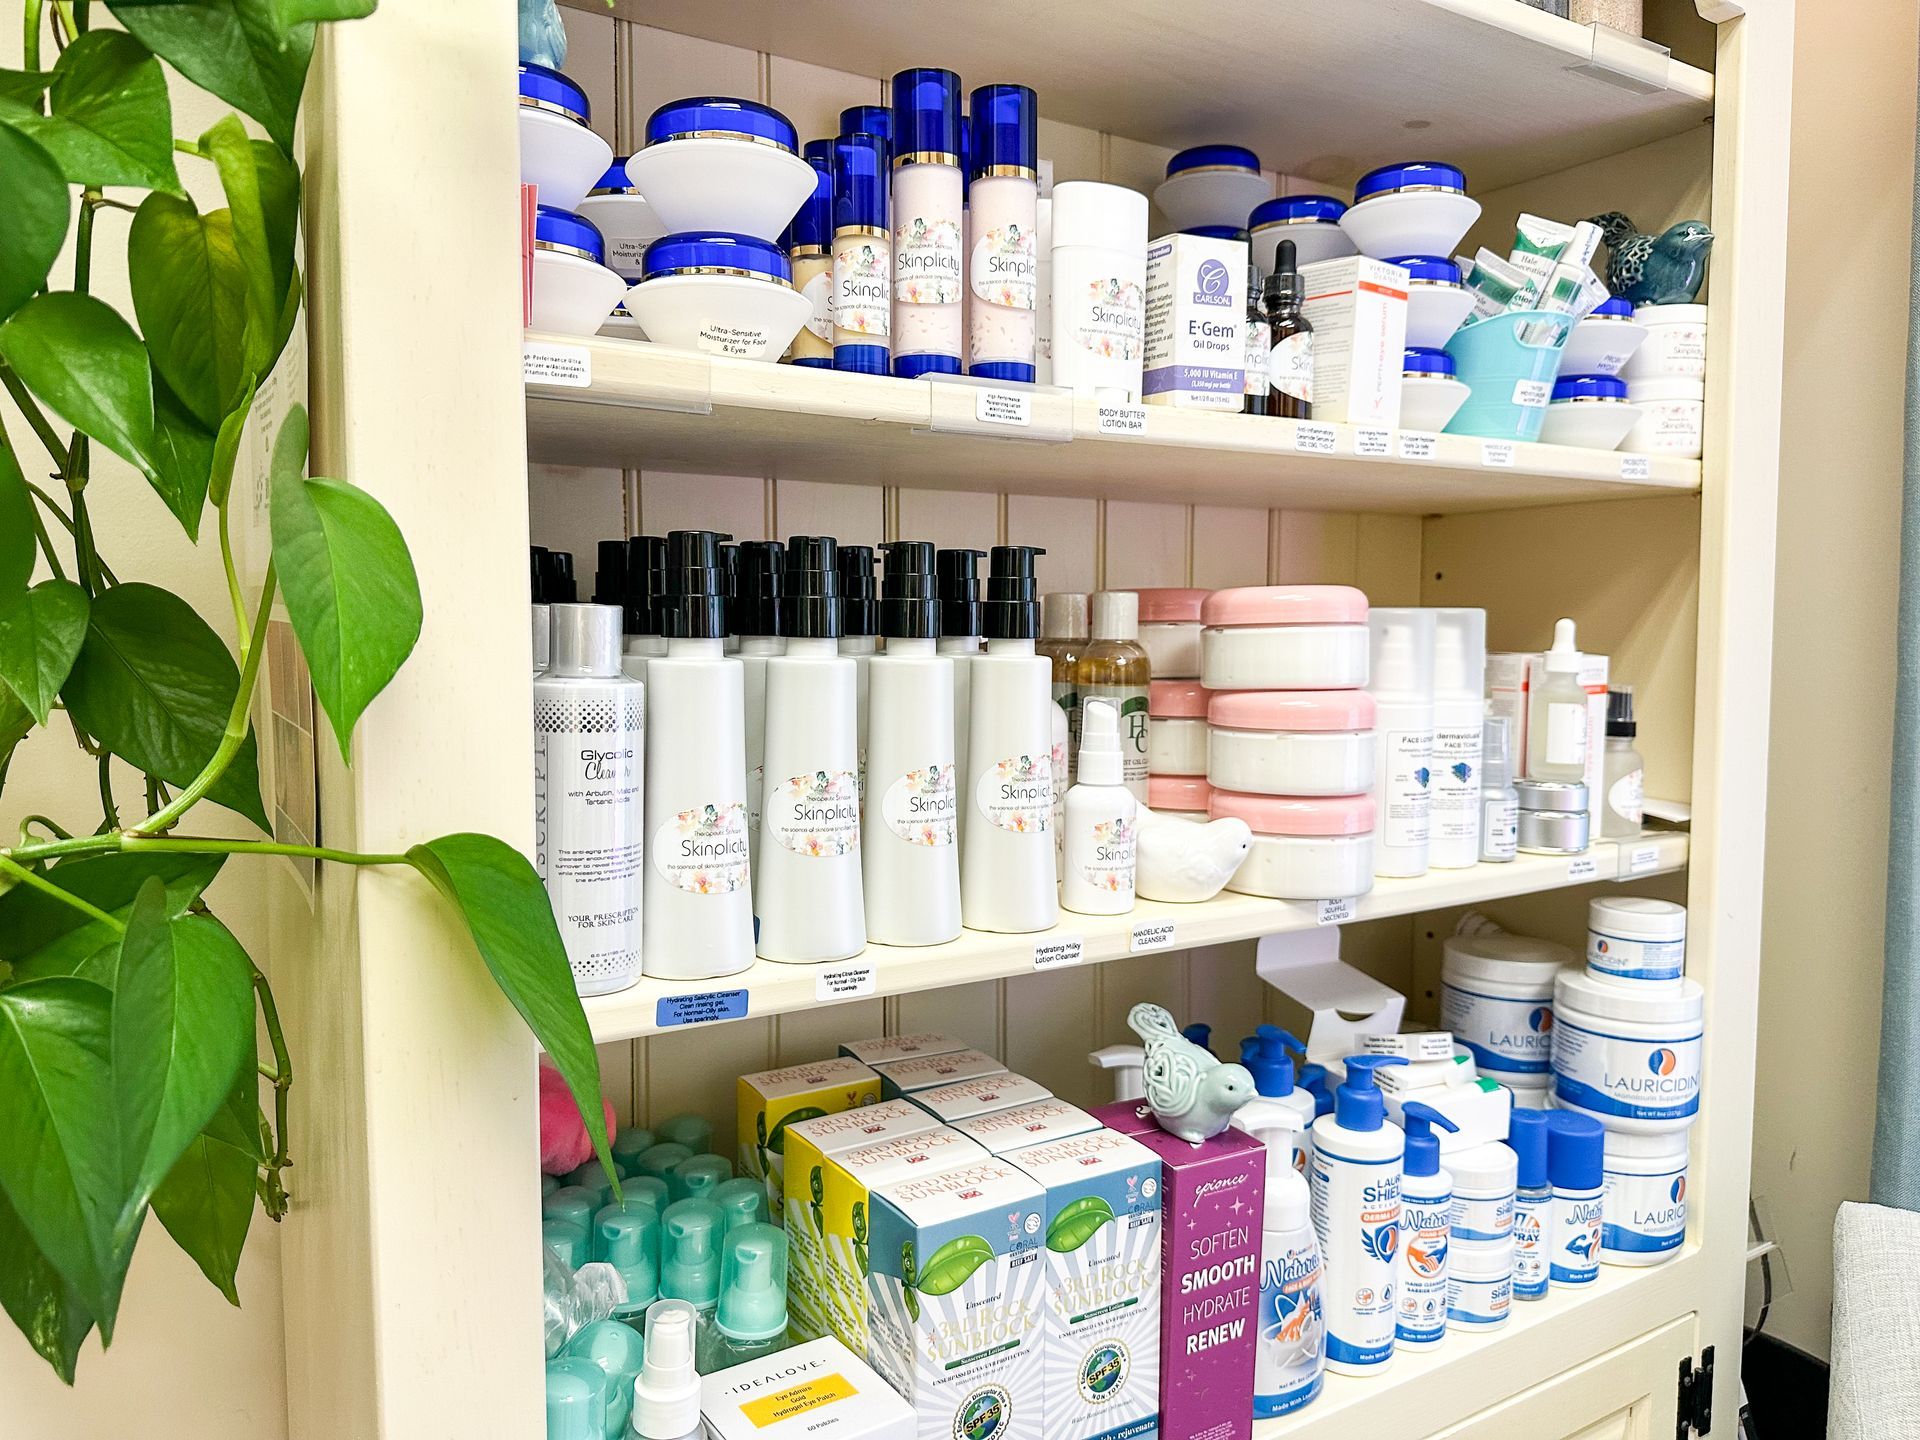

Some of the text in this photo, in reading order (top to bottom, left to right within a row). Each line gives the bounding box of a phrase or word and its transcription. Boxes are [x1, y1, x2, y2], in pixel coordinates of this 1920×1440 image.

[898, 252, 960, 276] Skinplicity
[1521, 255, 1538, 265] Hale
[1091, 306, 1141, 335] Skinplicity
[700, 331, 740, 345] Moisturizer
[710, 325, 761, 338] Ultra-Sensitive
[731, 346, 746, 354] Eyes
[1193, 340, 1230, 352] Oil Drops
[1184, 368, 1232, 381] 5,000 IU Vitamin
[1099, 408, 1146, 420] BODY BUTTER
[1102, 420, 1142, 429] LOTION BAR
[1402, 736, 1419, 744] FACE
[581, 748, 633, 762] Glycolic
[794, 803, 857, 824] Skinplicity
[681, 838, 747, 861] Skinplicity
[567, 906, 639, 923] YOUR PRESCRIPTION
[597, 919, 616, 927] SKIN
[617, 915, 634, 924] CARE
[1133, 928, 1160, 938] MANDELIC
[1137, 935, 1167, 945] CLEANSER
[1036, 942, 1081, 955] Hydrating Milky
[1035, 951, 1080, 963] Lotion Cleanser
[666, 991, 741, 1004] Hydrating Salicylic Cleanser
[684, 1008, 716, 1017] Normal-Oily
[694, 1015, 720, 1023] sparingly.
[1604, 1072, 1698, 1093] LAURICIDIN
[861, 1126, 886, 1135] USA
[1023, 1123, 1049, 1133] USA
[894, 1131, 944, 1148] ROCK
[904, 1152, 930, 1164] USA
[1077, 1155, 1102, 1167] USA
[943, 1165, 995, 1184] ROCK
[956, 1187, 983, 1200] USA
[1193, 1173, 1248, 1208] epionce
[1128, 1201, 1154, 1214] CORAL
[1363, 1212, 1392, 1223] DERMA
[1009, 1236, 1038, 1252] CORAL
[1190, 1225, 1249, 1260] SOFTEN
[1088, 1251, 1121, 1267] Unscented
[1101, 1258, 1147, 1283] ROCK
[1181, 1253, 1256, 1294] SMOOTH
[966, 1292, 1001, 1310] Unscented
[1054, 1274, 1152, 1316] SUNBLOCK
[1183, 1285, 1250, 1326] HYDRATE
[980, 1299, 1031, 1328] ROCK
[927, 1313, 1037, 1361] SUNBLOCK
[1186, 1317, 1246, 1355] RENEW
[1374, 1351, 1385, 1359] With
[1089, 1357, 1120, 1385] SPF 35
[775, 1385, 812, 1402] Eye Admire
[790, 1394, 806, 1404] Gold
[972, 1388, 997, 1401] Disruptor
[773, 1392, 837, 1418] Hydrogel Eye Patch
[1272, 1397, 1302, 1412] Made With
[807, 1417, 839, 1432] 60 Patches
[965, 1403, 1001, 1433] SPF 35
[1118, 1420, 1155, 1439] rejuvenate
